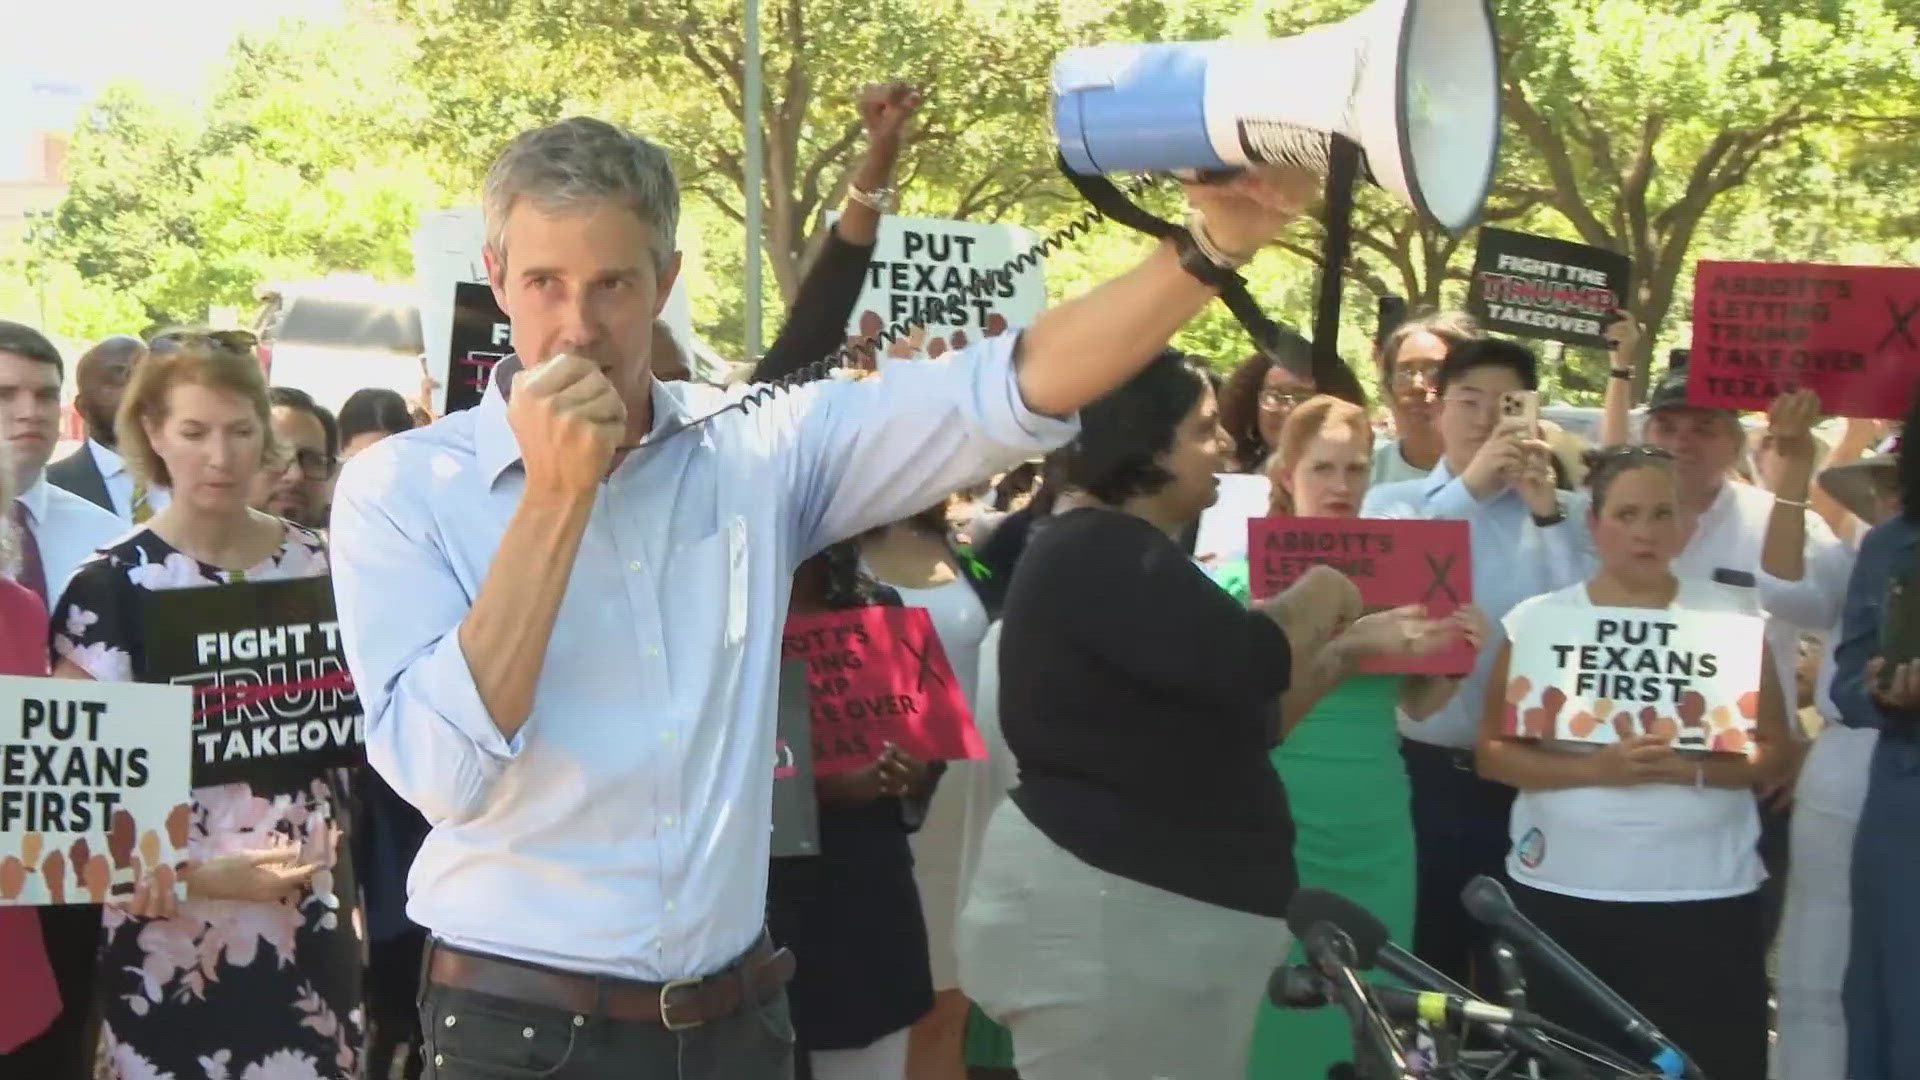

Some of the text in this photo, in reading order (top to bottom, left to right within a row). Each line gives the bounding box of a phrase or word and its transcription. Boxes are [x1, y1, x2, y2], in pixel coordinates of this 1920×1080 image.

[903, 231, 976, 263] PUT
[868, 261, 1015, 298] TEXANS
[1497, 254, 1608, 286] FIGHT THE
[1478, 272, 1619, 317] TRUMP
[1712, 276, 1854, 299] ABBOTT'S
[890, 294, 993, 328] FIRST
[1487, 303, 1602, 336] TAKEOVER
[1707, 299, 1830, 322] LETTING
[1709, 323, 1809, 343] TRUMP
[1264, 531, 1393, 553] ABBOTT'S
[197, 622, 311, 665] FIGHT
[1597, 619, 1678, 646] PUT
[1551, 644, 1718, 678] TEXANS
[168, 656, 359, 731] TRUM
[1576, 673, 1691, 703] FIRST
[21, 698, 108, 741] PUT
[0, 744, 149, 788] EXANS
[1, 791, 122, 832] FIRST
